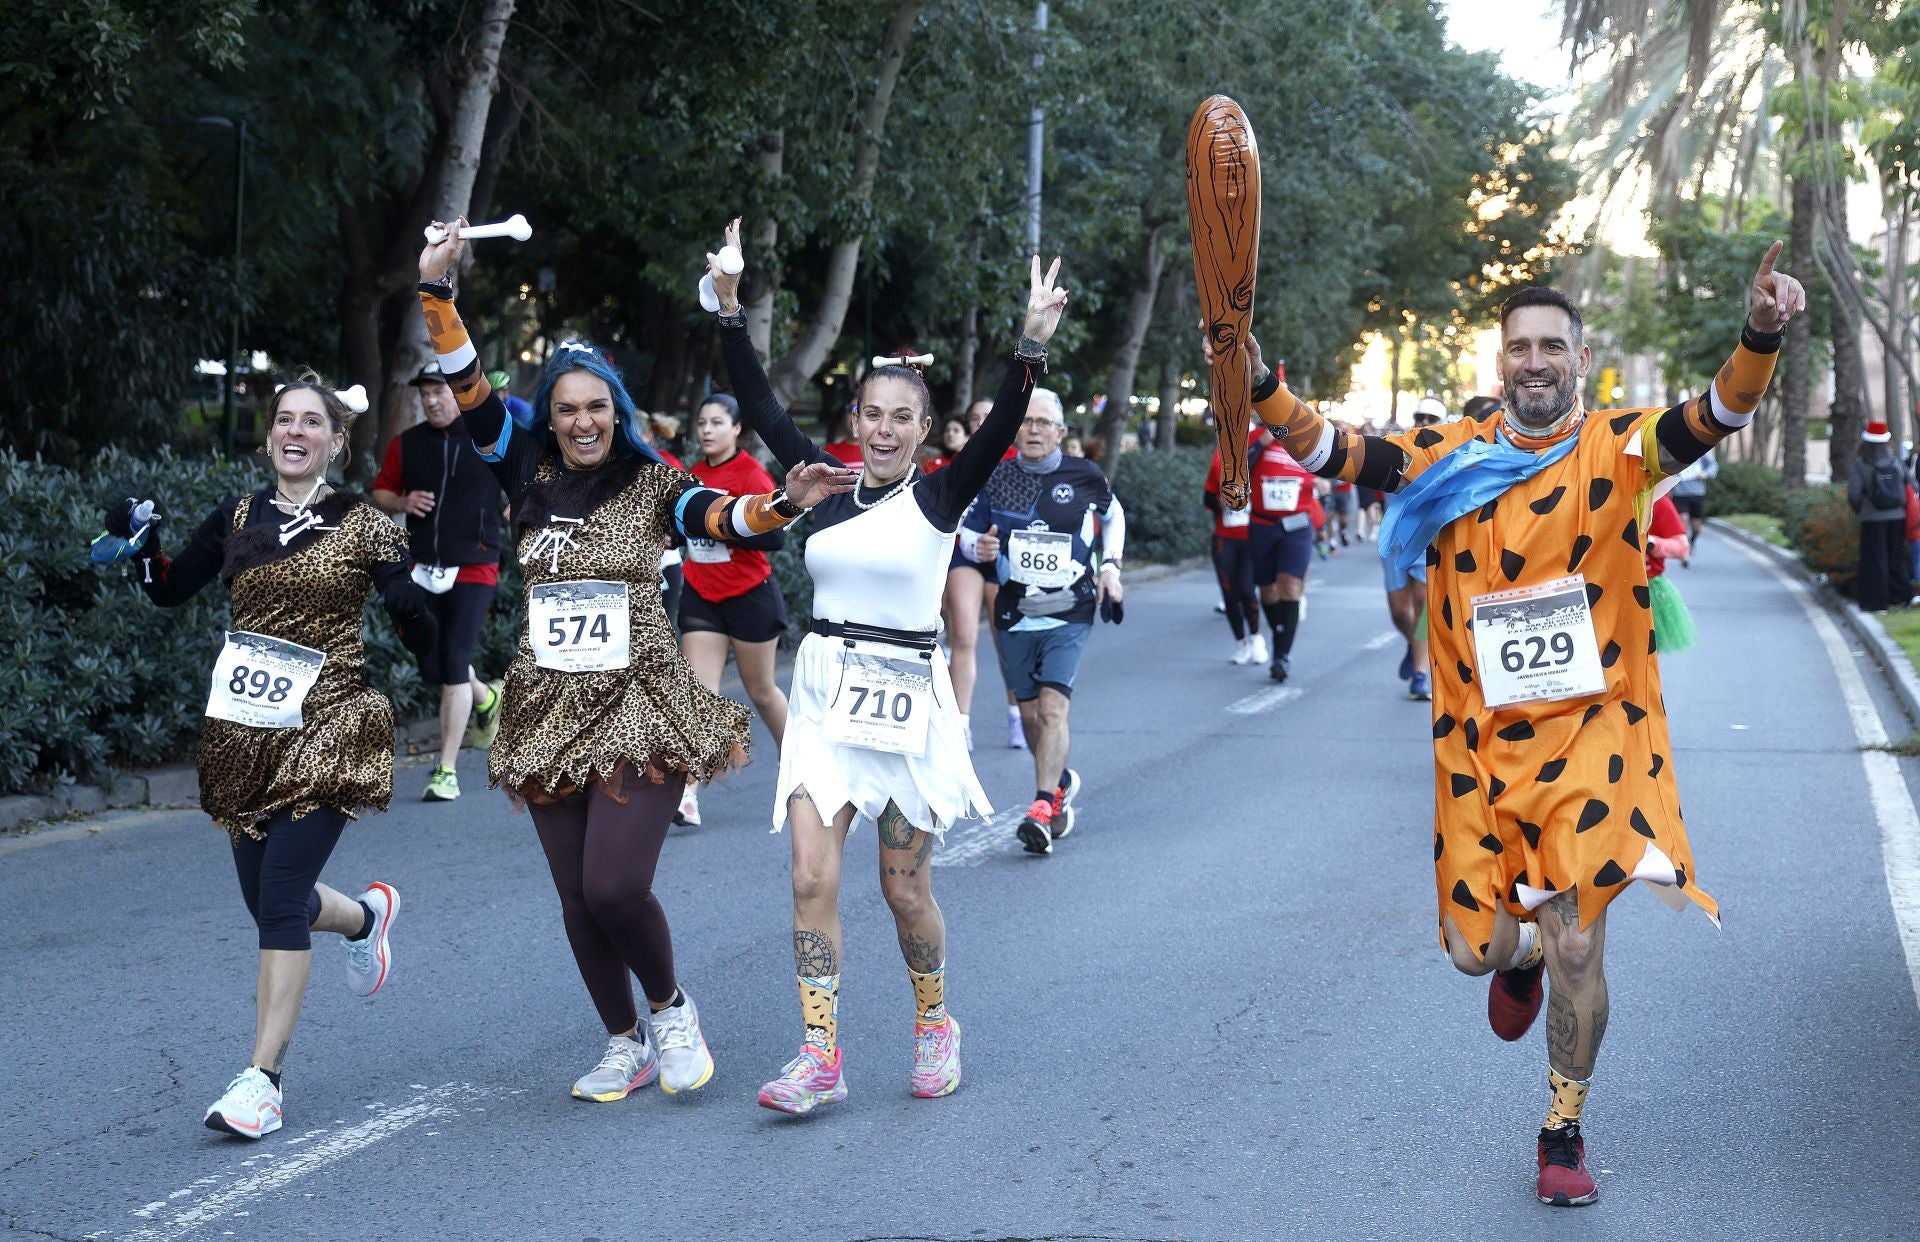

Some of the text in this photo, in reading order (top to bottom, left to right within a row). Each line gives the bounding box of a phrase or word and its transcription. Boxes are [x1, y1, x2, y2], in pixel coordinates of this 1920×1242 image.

[1021, 551, 1058, 571] 868
[1551, 603, 1584, 616] XIV
[548, 614, 611, 646] 574
[1500, 632, 1574, 673] 629
[229, 665, 293, 703] 898
[849, 686, 912, 722] 710
